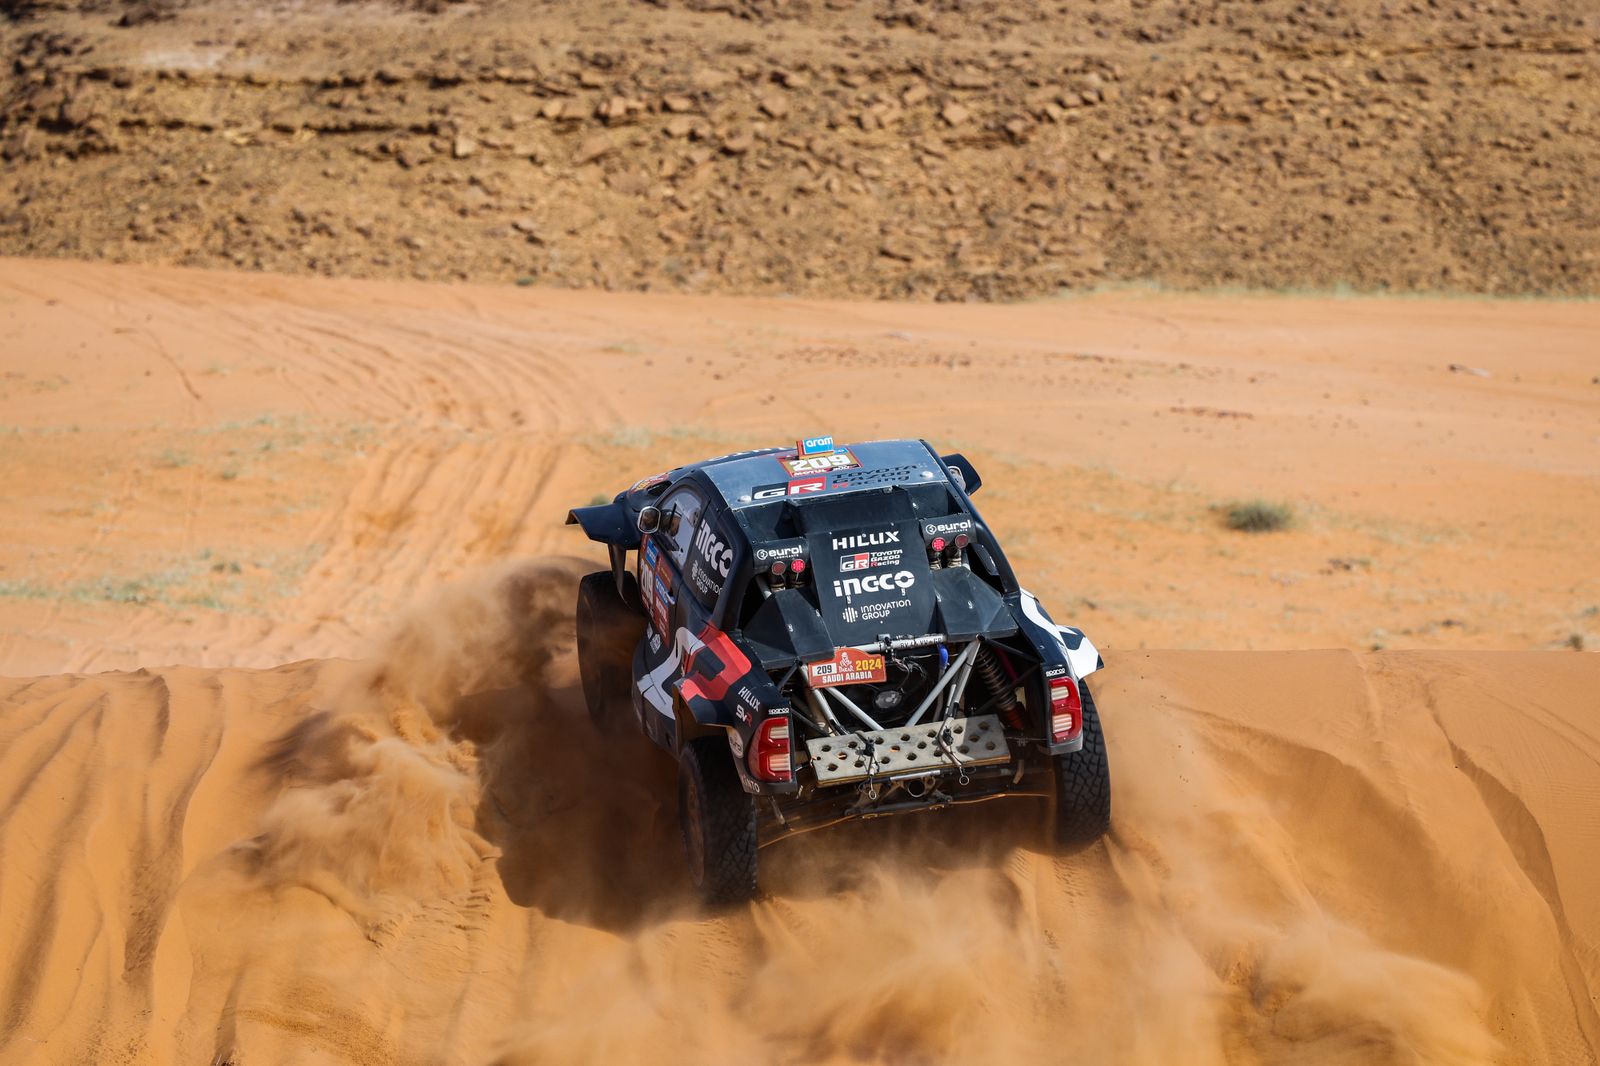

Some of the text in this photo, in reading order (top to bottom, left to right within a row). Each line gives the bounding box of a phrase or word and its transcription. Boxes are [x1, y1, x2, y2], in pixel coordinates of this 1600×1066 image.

[789, 455, 851, 471] 209
[832, 465, 918, 478] TOYOTA
[832, 471, 911, 483] GAZOO
[753, 482, 824, 500] GR
[937, 519, 971, 532] eurol
[832, 531, 900, 550] HILUX
[768, 545, 803, 557] eurol
[870, 549, 903, 558] TOYOTA
[870, 555, 900, 563] GAZOO
[870, 559, 900, 567] Racing
[860, 599, 912, 614] INNOVATION
[861, 610, 891, 621] GROUP
[816, 664, 833, 675] 209
[855, 659, 882, 672] 2024
[822, 671, 873, 684] SAUDI ARABIA
[737, 686, 761, 713] HILUX
